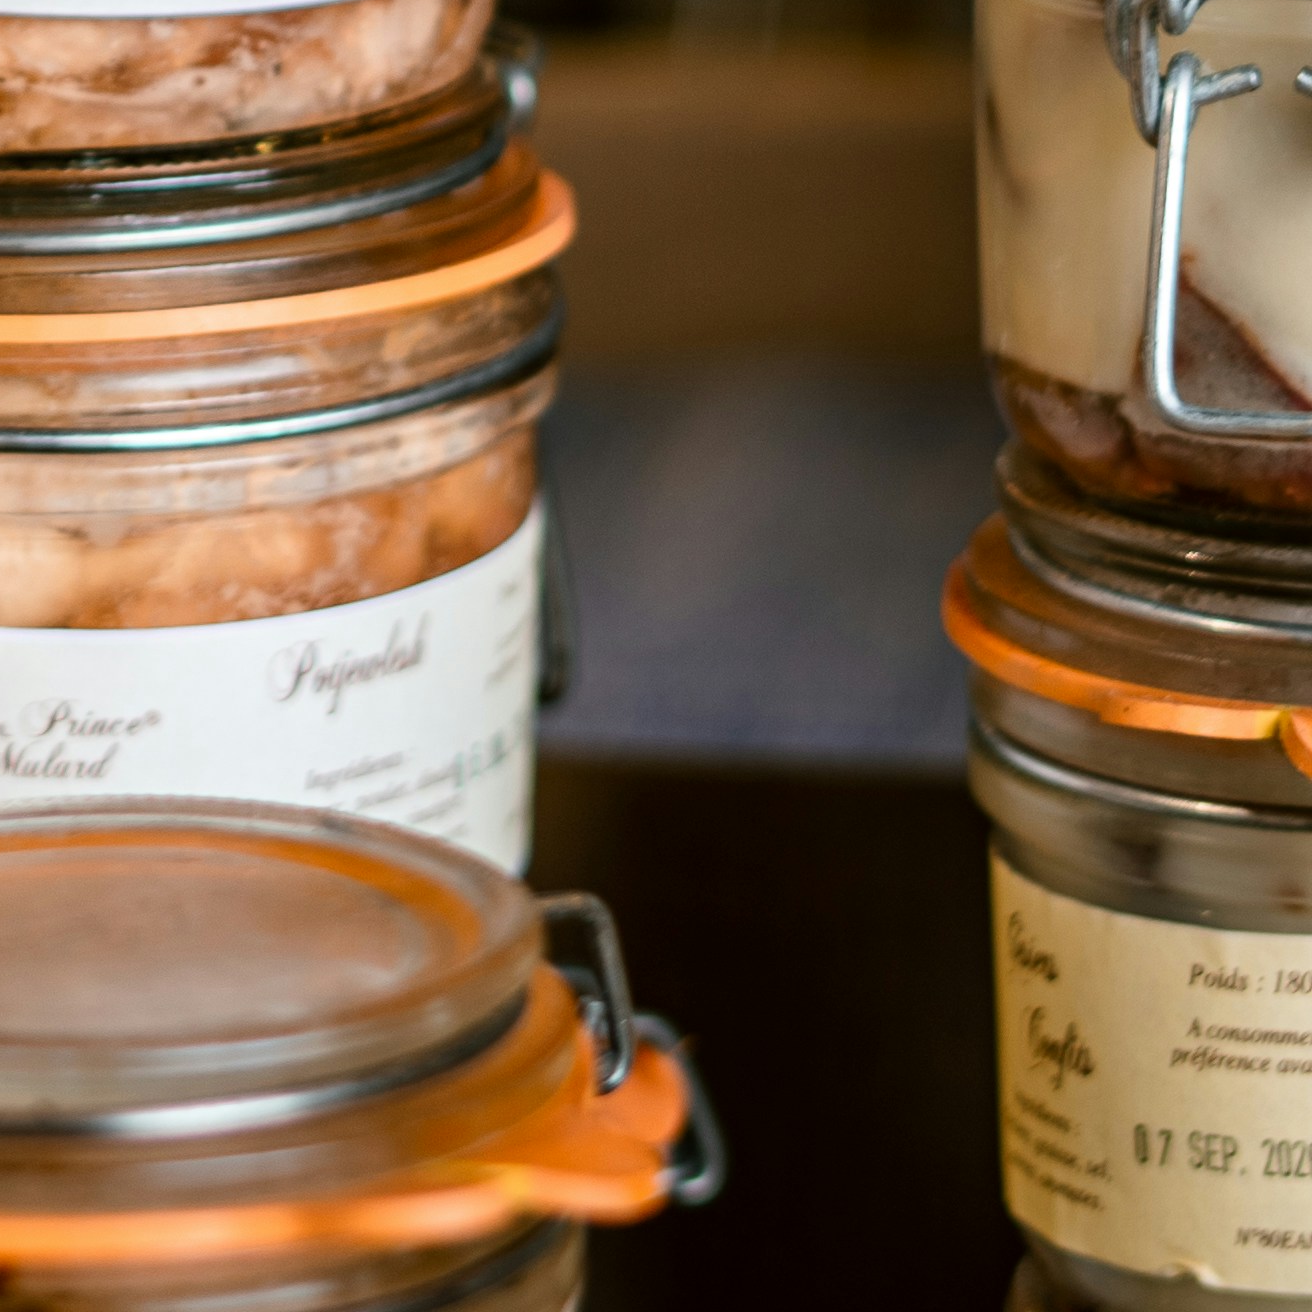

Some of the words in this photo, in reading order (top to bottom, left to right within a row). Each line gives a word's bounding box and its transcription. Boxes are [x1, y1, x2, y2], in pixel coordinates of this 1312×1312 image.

[1189, 962, 1249, 993] Poids
[1205, 1023, 1312, 1046] consomme
[1169, 1044, 1272, 1074] préférence
[1261, 1138, 1312, 1178] 202
